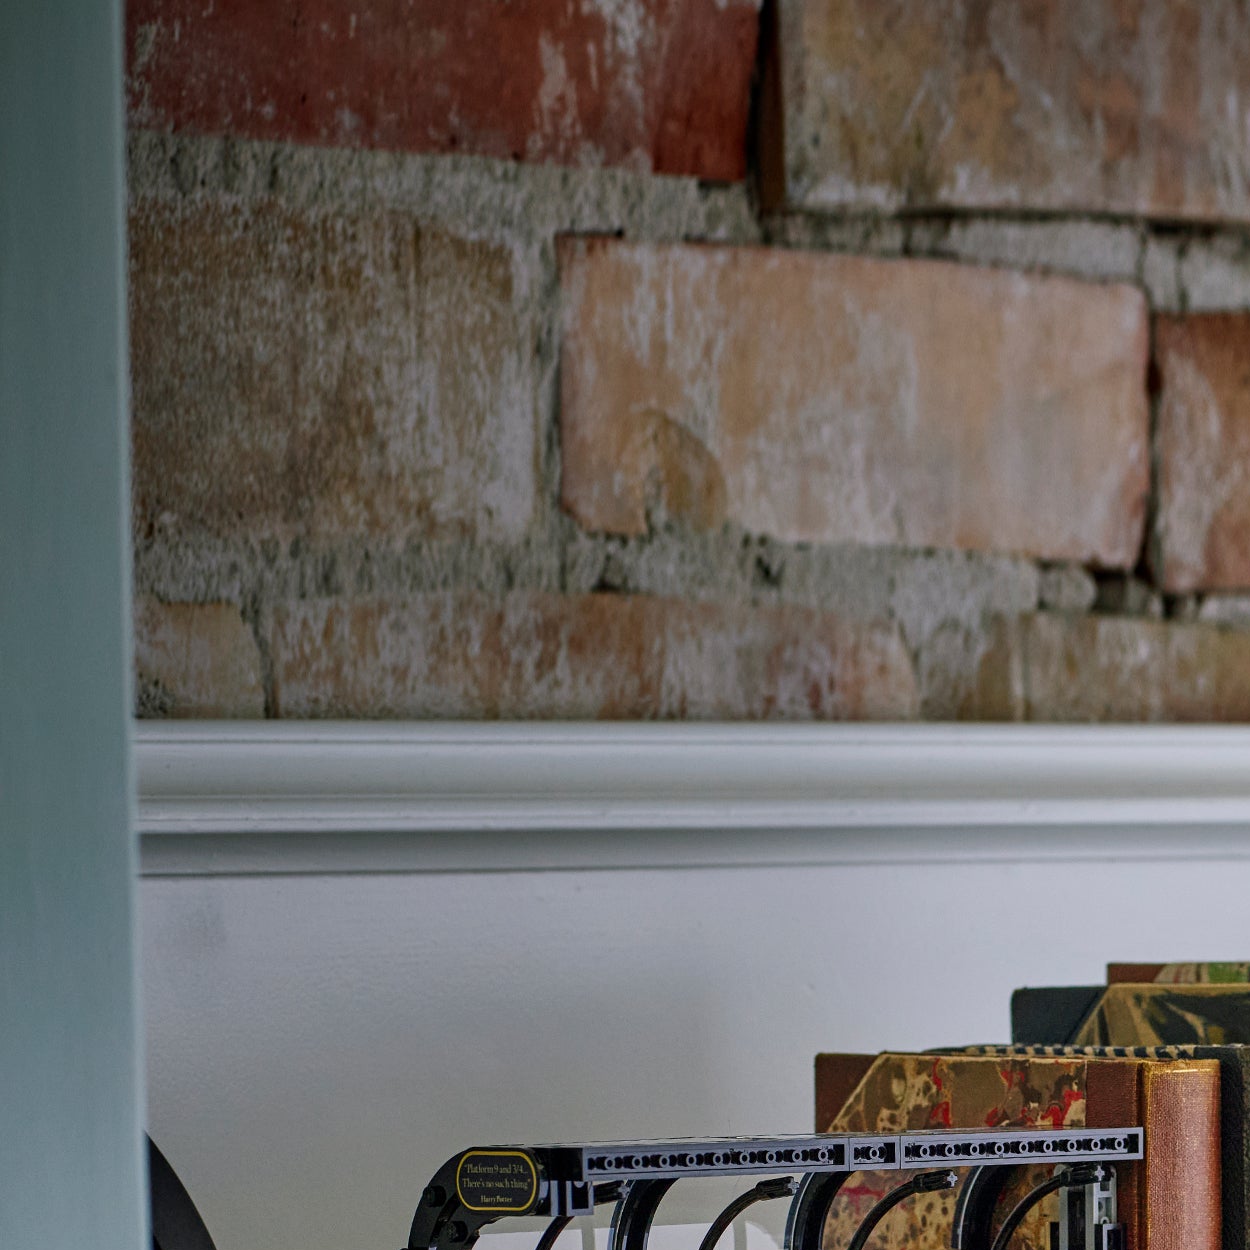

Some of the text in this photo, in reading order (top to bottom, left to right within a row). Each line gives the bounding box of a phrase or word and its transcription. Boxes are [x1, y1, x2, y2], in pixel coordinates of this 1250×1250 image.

[499, 1163, 512, 1174] and
[494, 1178, 510, 1188] such
[480, 1195, 513, 1204] Harry Potter
